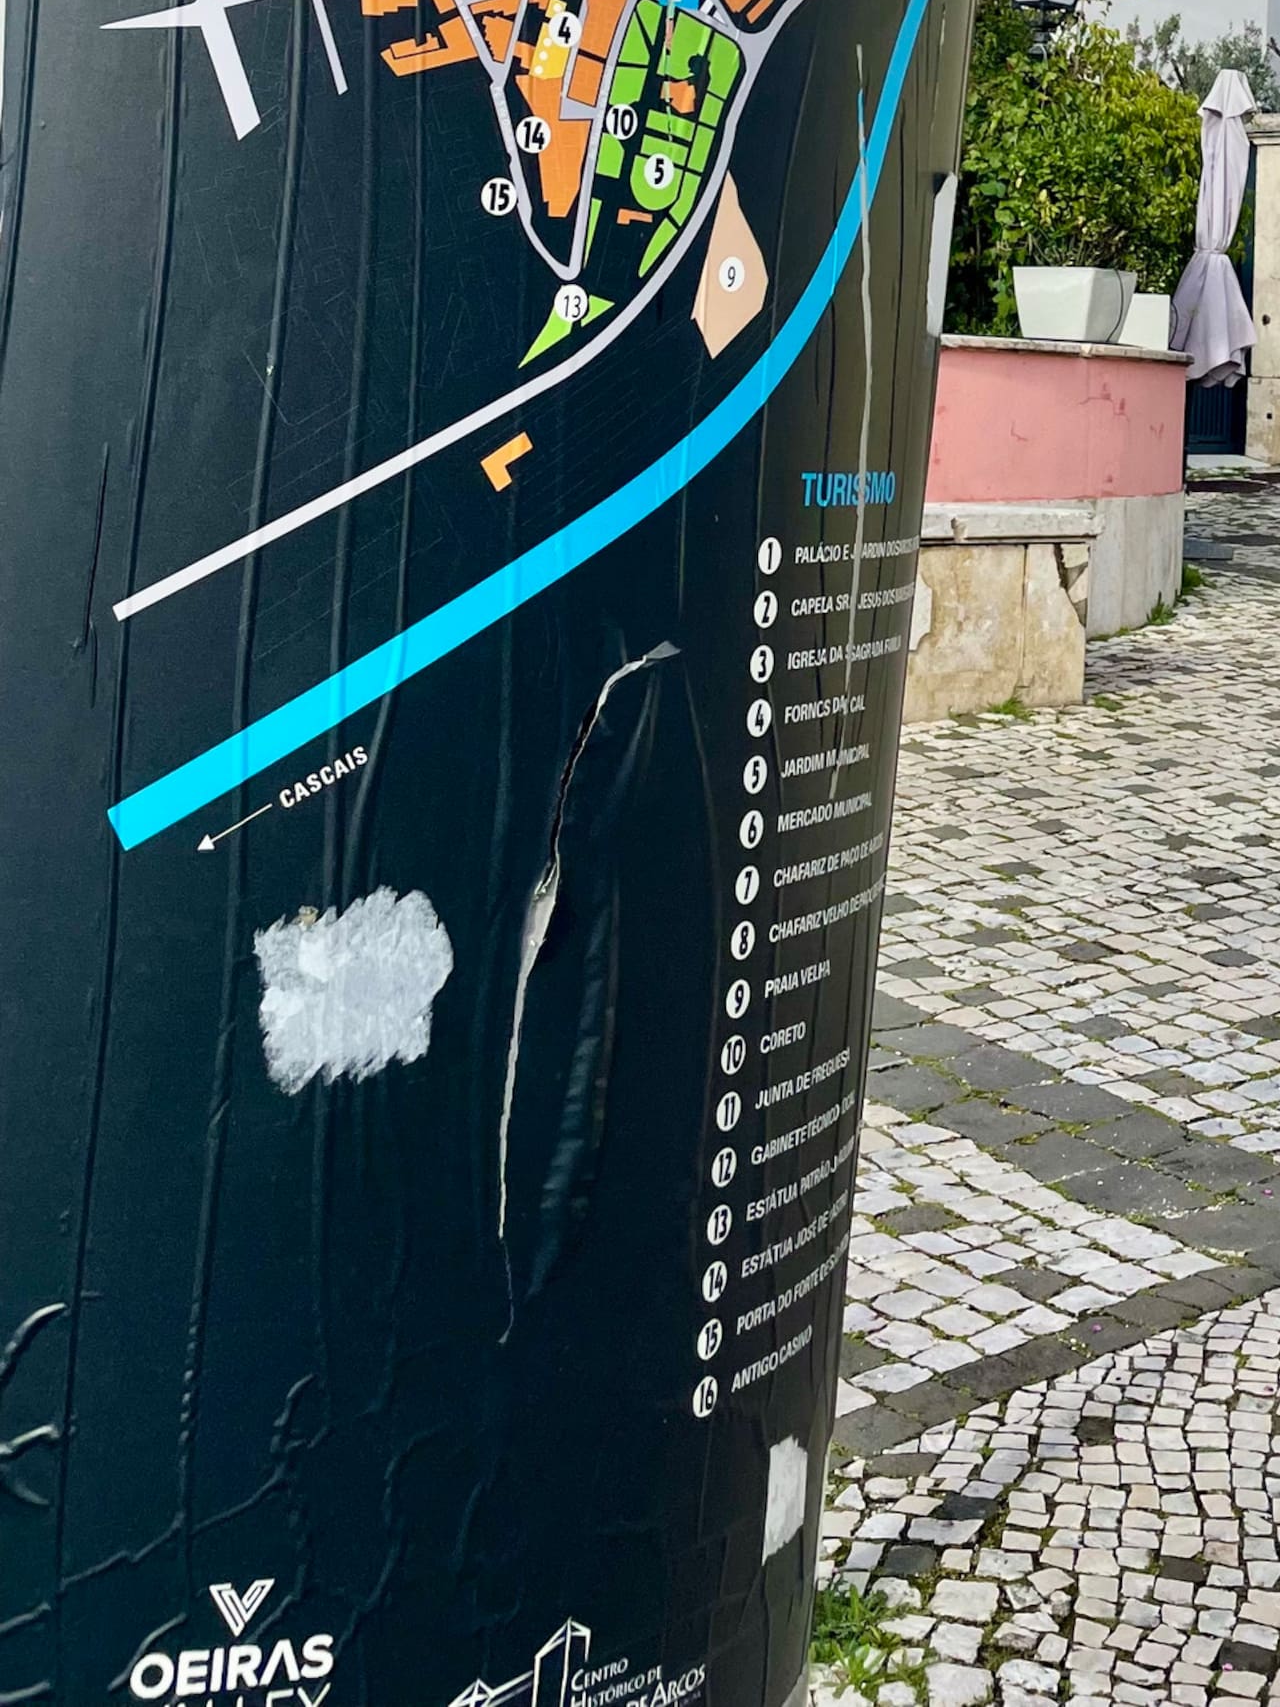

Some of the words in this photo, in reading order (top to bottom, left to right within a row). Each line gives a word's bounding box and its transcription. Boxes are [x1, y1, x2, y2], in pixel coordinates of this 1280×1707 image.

[558, 16, 571, 44] 4
[522, 122, 546, 149] 14
[612, 108, 633, 137] 10
[653, 158, 665, 184] 5
[487, 183, 511, 210] 15
[727, 266, 737, 287] 9
[563, 295, 581, 318] 13
[801, 471, 895, 507] TURISMO
[795, 541, 840, 564] PALÁCIO
[842, 544, 849, 562] E
[791, 595, 833, 617] CAPELA
[857, 590, 882, 611] JESUS
[787, 648, 827, 670] IGREJA
[829, 644, 843, 663] DA
[850, 694, 865, 713] CAL
[279, 745, 369, 809] CASCAIS
[781, 753, 823, 779] JARDIM
[777, 804, 832, 833] MERCADO
[833, 791, 873, 818] MUNICIPAL
[773, 858, 826, 888] CHAFARIZ
[827, 853, 840, 874] DE
[768, 910, 822, 943] CHAFARIZ
[822, 900, 849, 926] VELHO
[765, 974, 799, 998] PRAIA
[800, 959, 830, 985] VELHA
[760, 1021, 806, 1054] CORETO
[755, 1078, 794, 1110] JUNTA
[795, 1071, 811, 1093] DE
[751, 1125, 807, 1165] GABINETE
[807, 1103, 840, 1140] TÉCNICO
[746, 1182, 798, 1222] ESTÁTUA
[799, 1160, 830, 1196] PATRÃO
[741, 1236, 793, 1279] ESTÁTUA
[794, 1216, 817, 1250] JOSÉ
[736, 1300, 776, 1336] PORTA
[776, 1289, 793, 1314] DO
[793, 1267, 820, 1303] FORTE
[731, 1352, 778, 1393] ANTIGO
[778, 1324, 813, 1365] CASINO
[129, 1633, 334, 1699] OEIRAS
